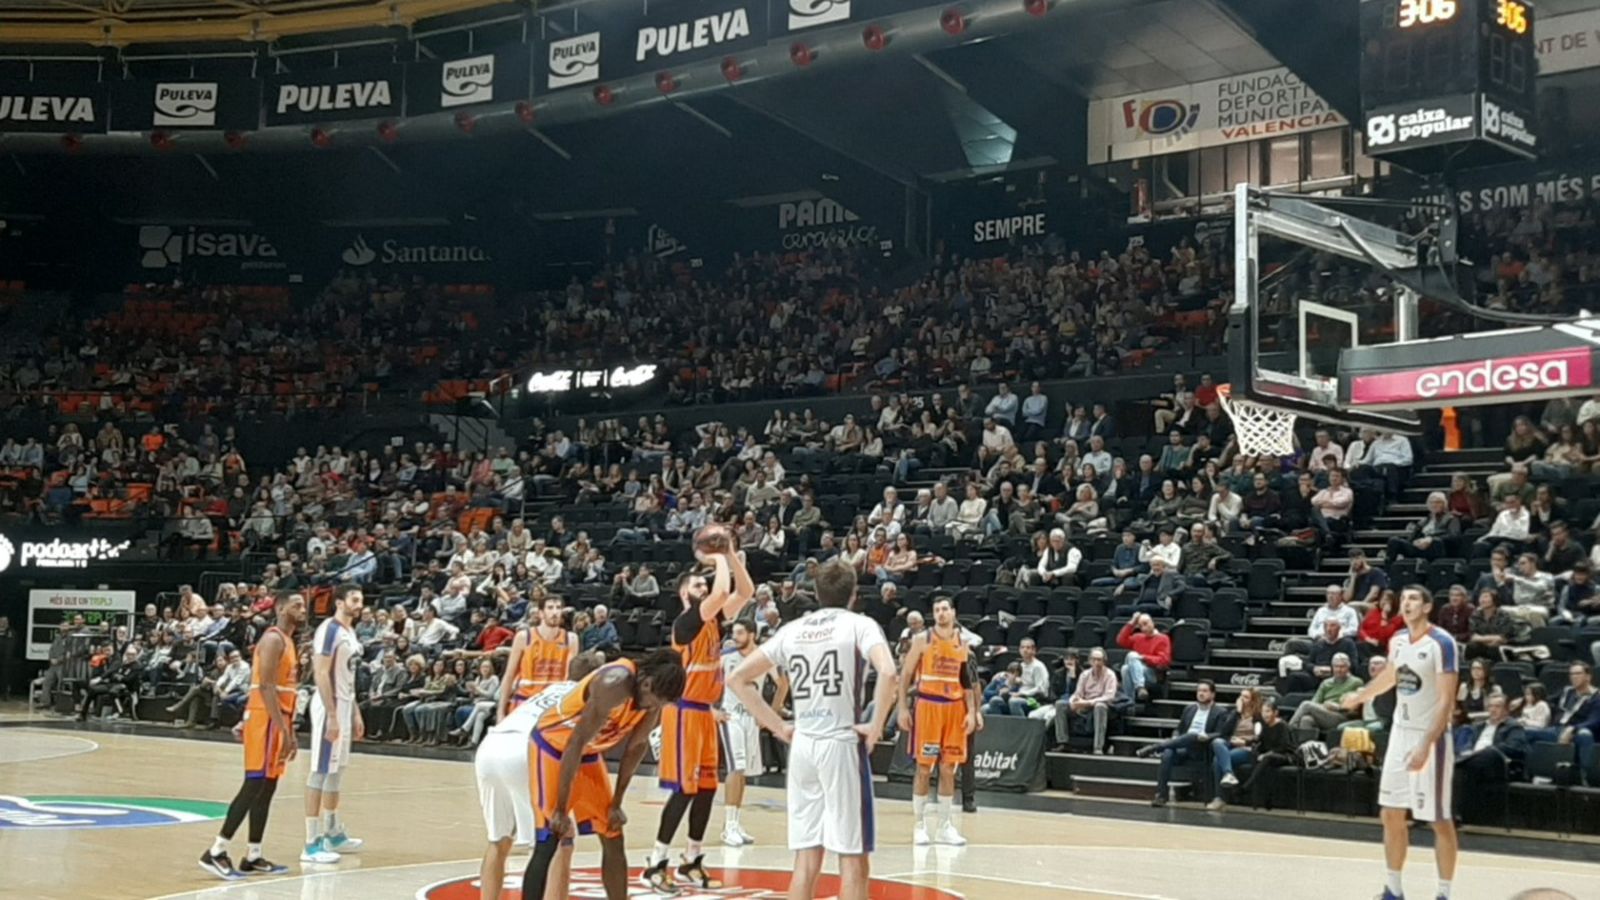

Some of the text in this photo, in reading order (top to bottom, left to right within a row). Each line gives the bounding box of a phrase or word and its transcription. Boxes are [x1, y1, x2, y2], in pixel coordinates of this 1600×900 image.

[636, 8, 750, 61] PULEVA
[1561, 32, 1588, 51] DE
[553, 40, 597, 61] PULEVA
[446, 63, 491, 81] PULEVA
[159, 88, 213, 101] PULEVA
[277, 80, 391, 113] PULEVA
[1221, 112, 1339, 140] VALENCIA
[1398, 108, 1446, 127] caixa
[1399, 115, 1474, 142] popular
[1479, 184, 1528, 211] SOM
[1536, 173, 1584, 204] MÉS
[974, 213, 1046, 243] SEMPRE
[1416, 359, 1568, 398] endesa
[789, 649, 843, 699] 24
